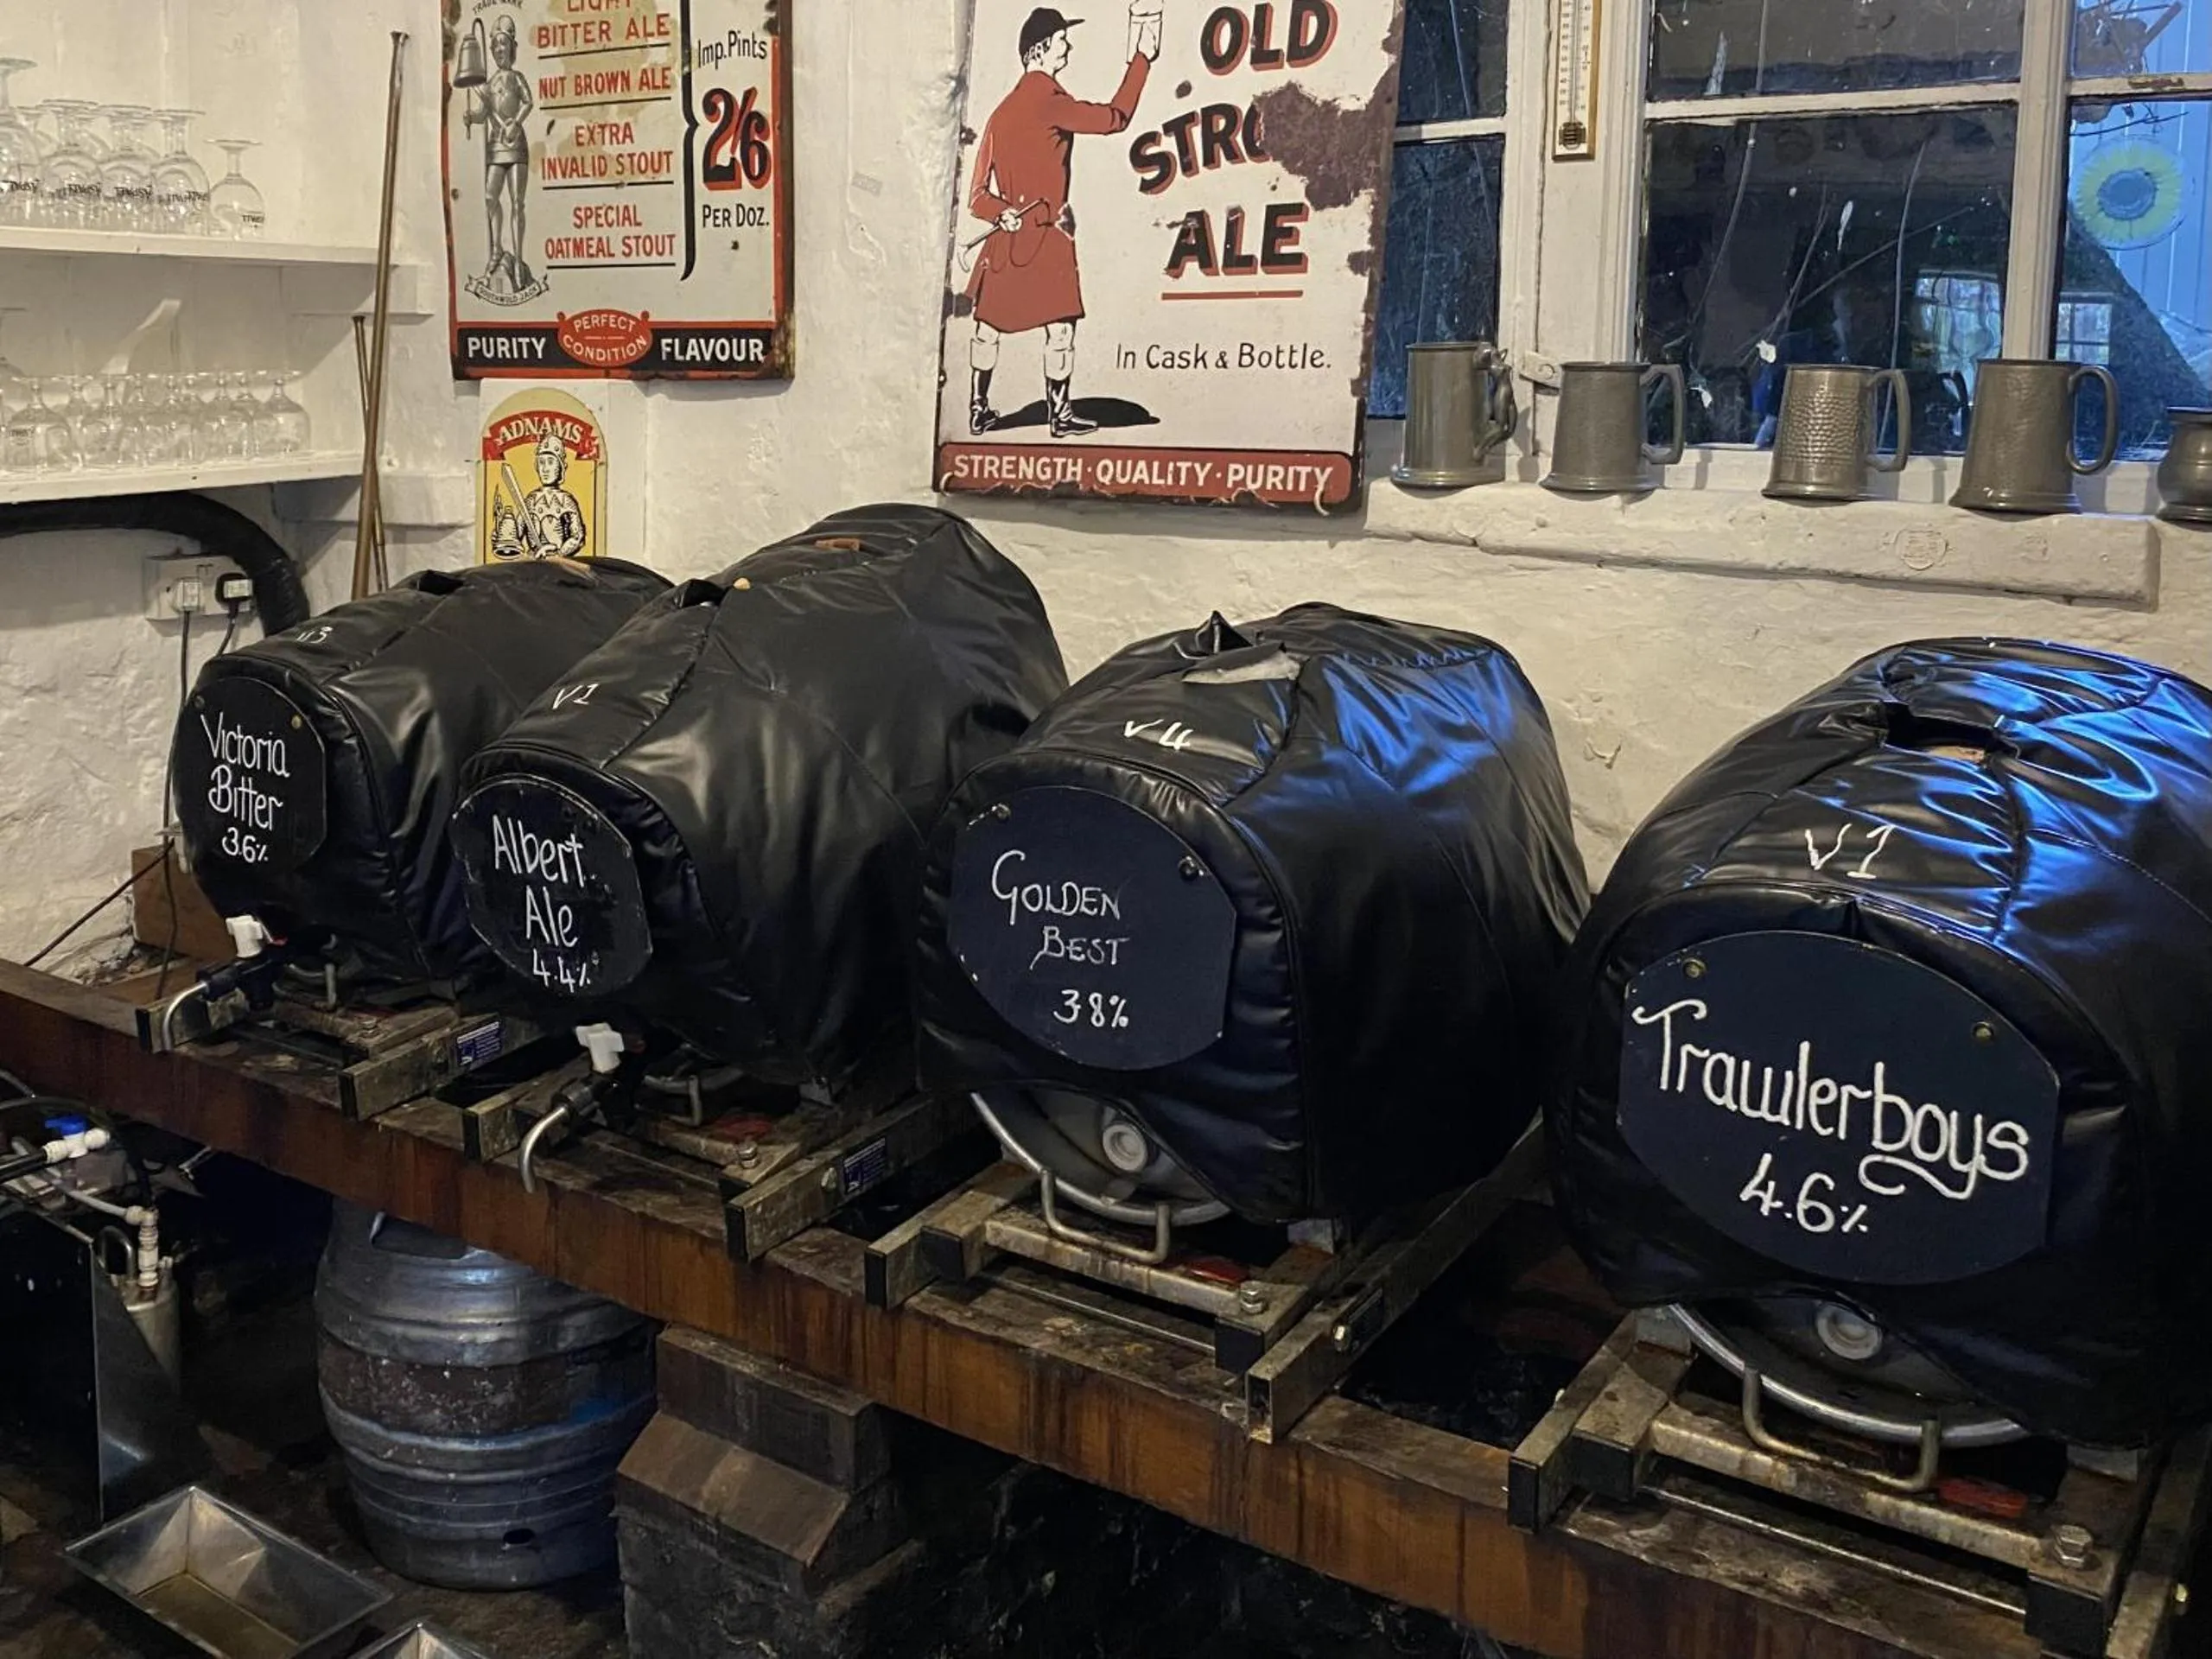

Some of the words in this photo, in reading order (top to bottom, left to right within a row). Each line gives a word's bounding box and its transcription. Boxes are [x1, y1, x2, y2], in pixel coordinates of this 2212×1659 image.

[537, 20, 612, 49] BITTER
[626, 13, 671, 41] ALE
[698, 40, 728, 71] Imp.
[728, 29, 768, 61] Pints
[1200, 0, 1338, 76] OLD
[539, 76, 567, 100] NUT
[575, 71, 632, 94] BROWN
[639, 67, 671, 92] ALE
[575, 123, 635, 146] EXTRA
[702, 86, 772, 191] 2/6
[541, 153, 608, 181] INVALID
[616, 150, 674, 178] STOUT
[573, 204, 643, 229] SPECIAL
[702, 205, 732, 229] PER
[735, 203, 771, 228] DOZ.
[545, 236, 616, 260] OATMEAL
[622, 233, 677, 257] STOUT
[1164, 201, 1310, 279] ALE
[573, 314, 637, 333] PERFECT
[467, 336, 547, 359] PURITY
[563, 334, 647, 361] CONDITION
[661, 338, 765, 363] FLAVOUR
[1116, 343, 1137, 370] In
[1146, 342, 1208, 370] Cask
[1214, 350, 1229, 370] &
[1237, 342, 1332, 370] Bottle.
[497, 416, 584, 446] ADNAMS
[953, 454, 1084, 483] STRENGTH
[1096, 459, 1210, 487] QUALITY
[1226, 464, 1333, 493] PURITY
[200, 712, 290, 779] Victoria
[208, 766, 283, 830] Bitter
[492, 814, 585, 888] Albert
[1805, 823, 1896, 880] V1
[991, 849, 1121, 925] GOLDEN
[525, 884, 579, 948] Ale
[1029, 925, 1130, 970] BEST
[532, 947, 591, 994] 4.4%
[1632, 998, 2029, 1200] Trawlerboys
[1739, 1152, 1868, 1233] 4.6%
